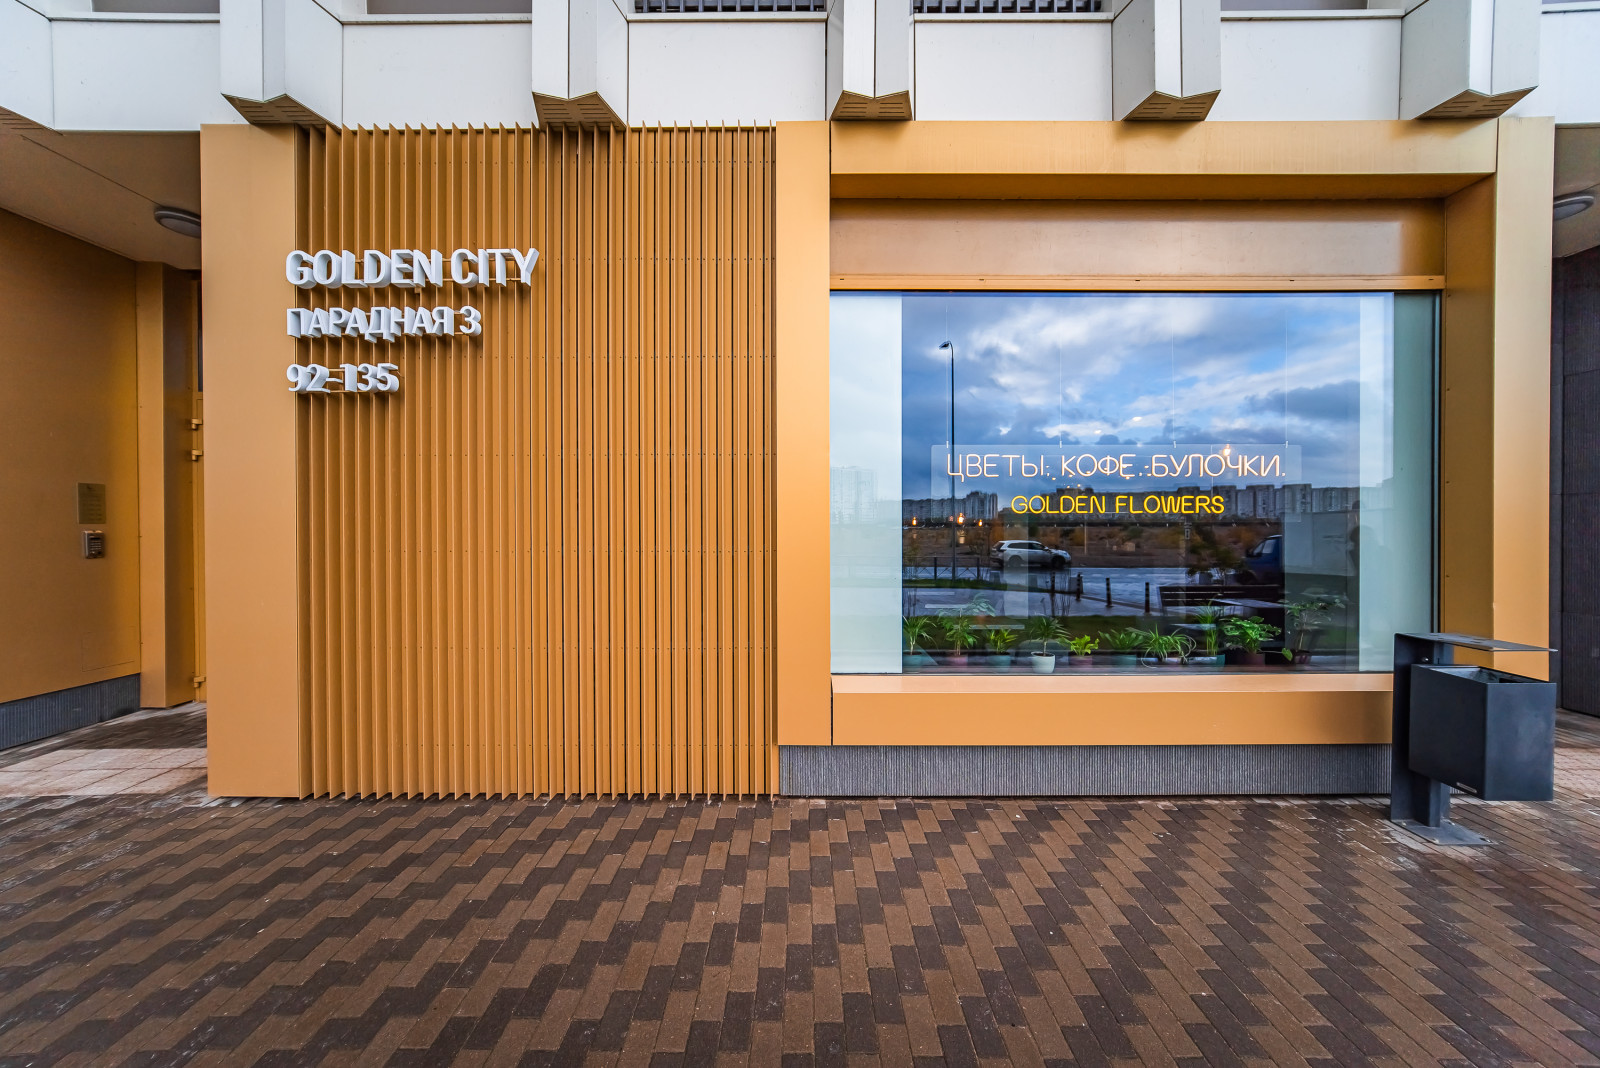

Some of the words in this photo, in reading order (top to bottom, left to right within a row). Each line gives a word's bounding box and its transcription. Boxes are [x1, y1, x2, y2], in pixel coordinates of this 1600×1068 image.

[286, 249, 443, 289] GOLDEN
[451, 248, 539, 289] CITY
[286, 306, 455, 343] ПАРАДНАЯ
[459, 305, 482, 336] 3
[286, 363, 400, 393] 92-135
[1011, 495, 1106, 514] GOLDEN
[1115, 495, 1225, 514] FLOWERS
